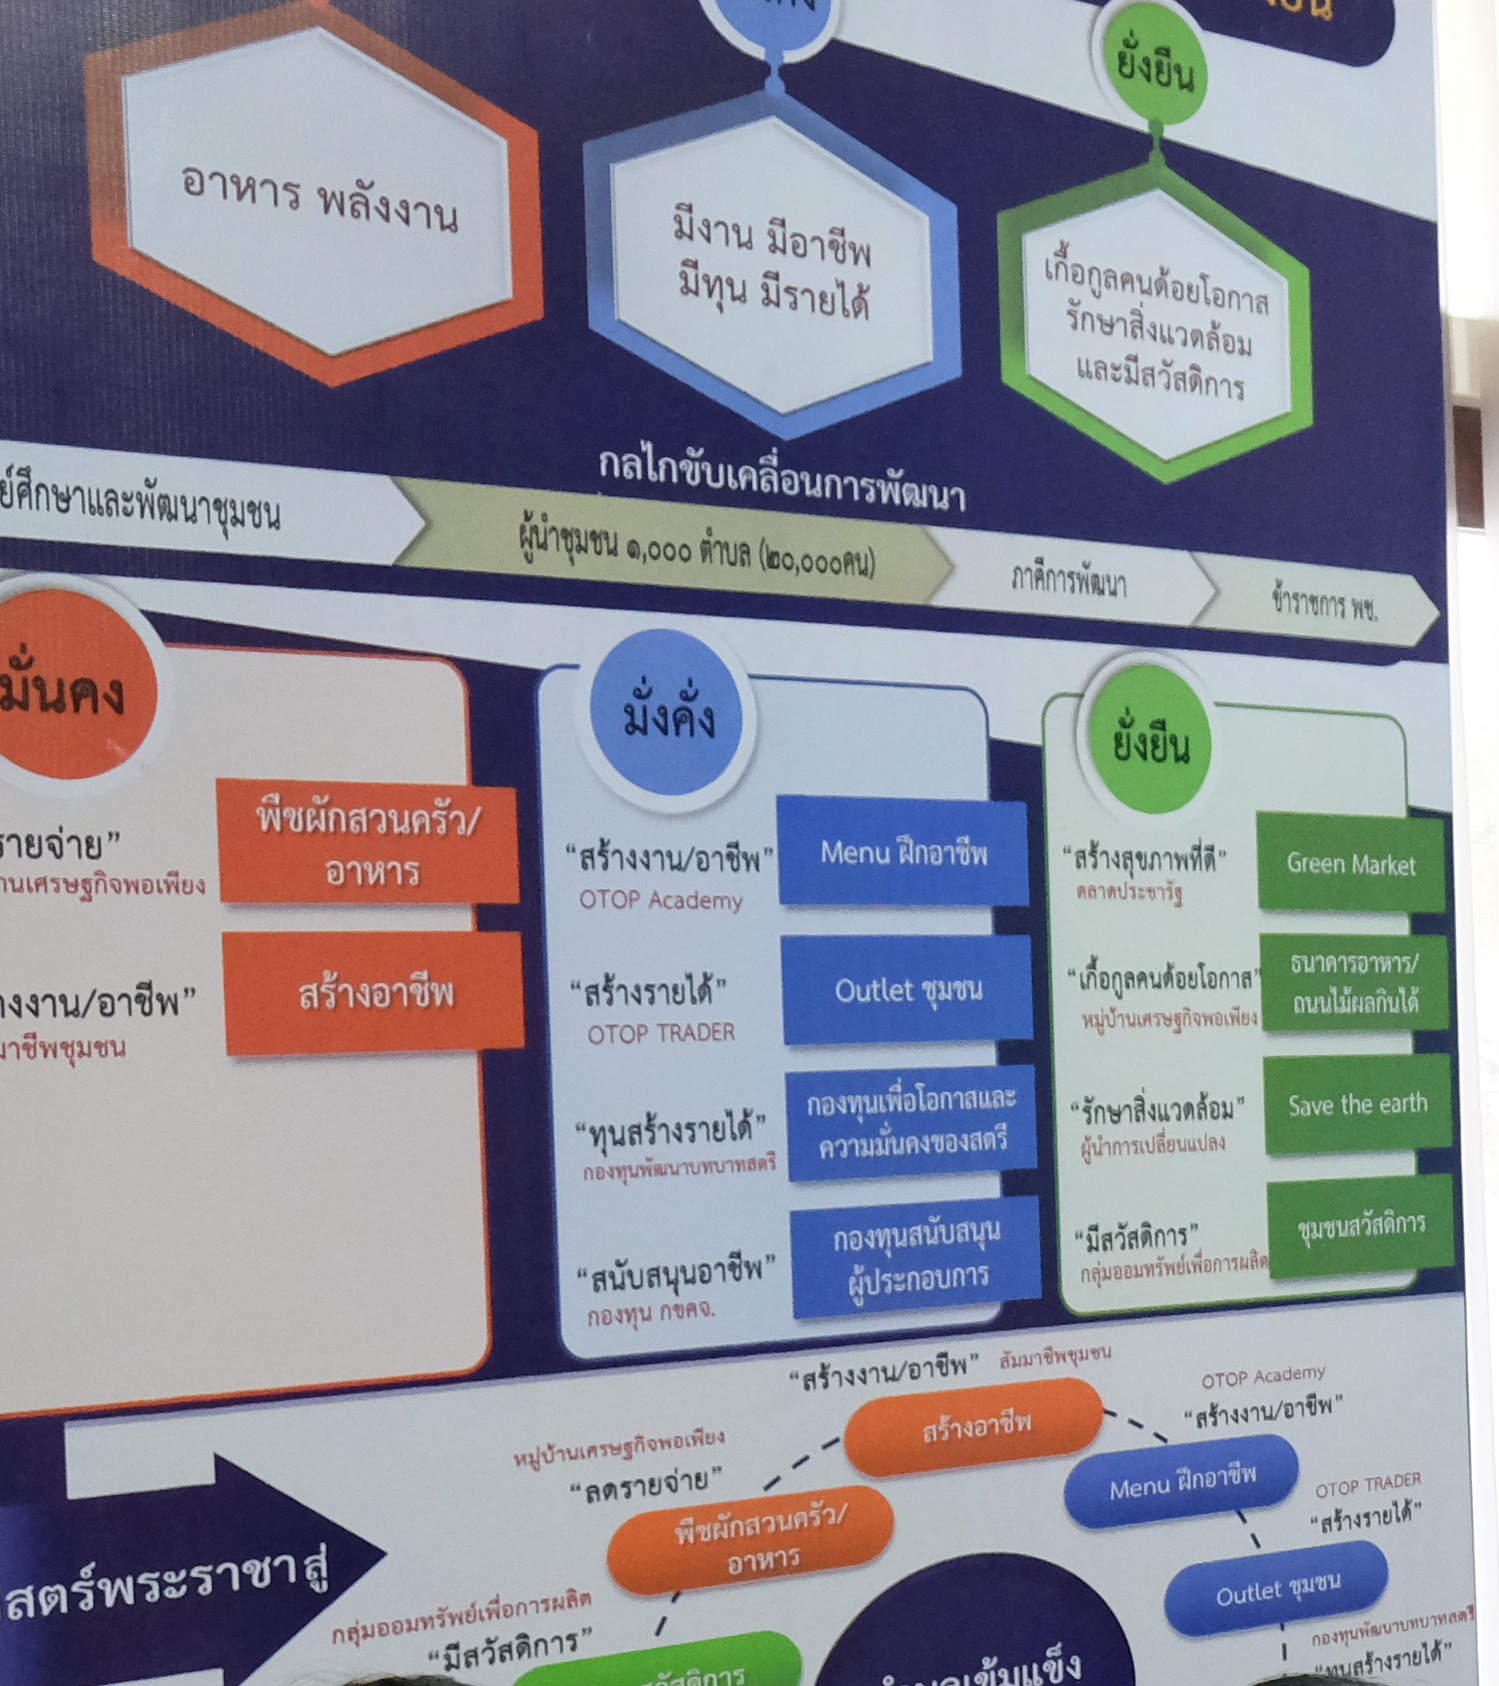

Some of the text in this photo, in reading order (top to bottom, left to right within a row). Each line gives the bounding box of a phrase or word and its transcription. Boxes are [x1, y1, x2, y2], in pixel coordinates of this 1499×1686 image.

[1117, 30, 1196, 93] ยั่งยืน
[183, 166, 458, 233] อาหาร พลังงาน
[673, 202, 872, 268] มีงาน มีอาชีพ
[679, 265, 870, 323] มีทุน มีรายได้
[1044, 239, 1270, 317] เกื้อกูลคนด้อยโอกาส
[1066, 301, 1253, 358] รักษาสิ่งแวดล้อม
[1077, 353, 1245, 402] และมีสวัสดิการ
[599, 439, 966, 512] กลไกขับเคลื่อนการพัฒนา
[520, 508, 618, 564] ผู้นำชุมชน
[700, 528, 752, 567] ตำบล
[1012, 557, 1127, 598] ภาคีการพัฒนา
[1272, 578, 1346, 617] ข้าราชการ
[0, 642, 125, 716] มั่นคง
[623, 675, 716, 739] มั่งคั่ง
[1113, 707, 1191, 764] ยั่งยืน
[256, 792, 482, 839] พืชผักสวนครัว/
[821, 835, 989, 866] Menu ฝึกอาชีพ
[1287, 852, 1417, 877] Green Market
[325, 858, 421, 887] อาหาร
[580, 889, 743, 914] OTOP Academy
[1291, 953, 1420, 975] ธนาคารอาหาร/
[298, 970, 454, 1011] สร้างอาชีพ
[835, 978, 984, 1011] Outlet ชุมชน
[1293, 986, 1420, 1015] ถนนไม้ผลกินได้
[587, 1022, 736, 1046] OTOP TRADER
[806, 1077, 1017, 1122] กองทุนเพื่อโอกาสและ
[1289, 1091, 1429, 1117] Save the earth
[820, 1122, 1009, 1160] ความมั่นคงของสตรี
[1080, 1126, 1227, 1166] ผู้นำการเปลี่ยนแปลง
[833, 1216, 1002, 1257] กองทุนสนับสนุน
[1298, 1209, 1427, 1249] ชุมชนสวัสดิการ
[847, 1262, 990, 1309] ผู้ประกอบการ
[587, 1302, 653, 1331] กองทุน
[1201, 1364, 1326, 1390] OTOP Academy
[922, 1409, 1033, 1445] สร้างอาชีพ
[1110, 1461, 1257, 1500] Menu ฝึกอาชีพ
[1315, 1471, 1422, 1499] OTOP TRADER
[674, 1502, 849, 1546] พืชผักสวนครัว/
[728, 1546, 801, 1575] อาหาร
[1216, 1571, 1342, 1607] Outlet ชุมชน
